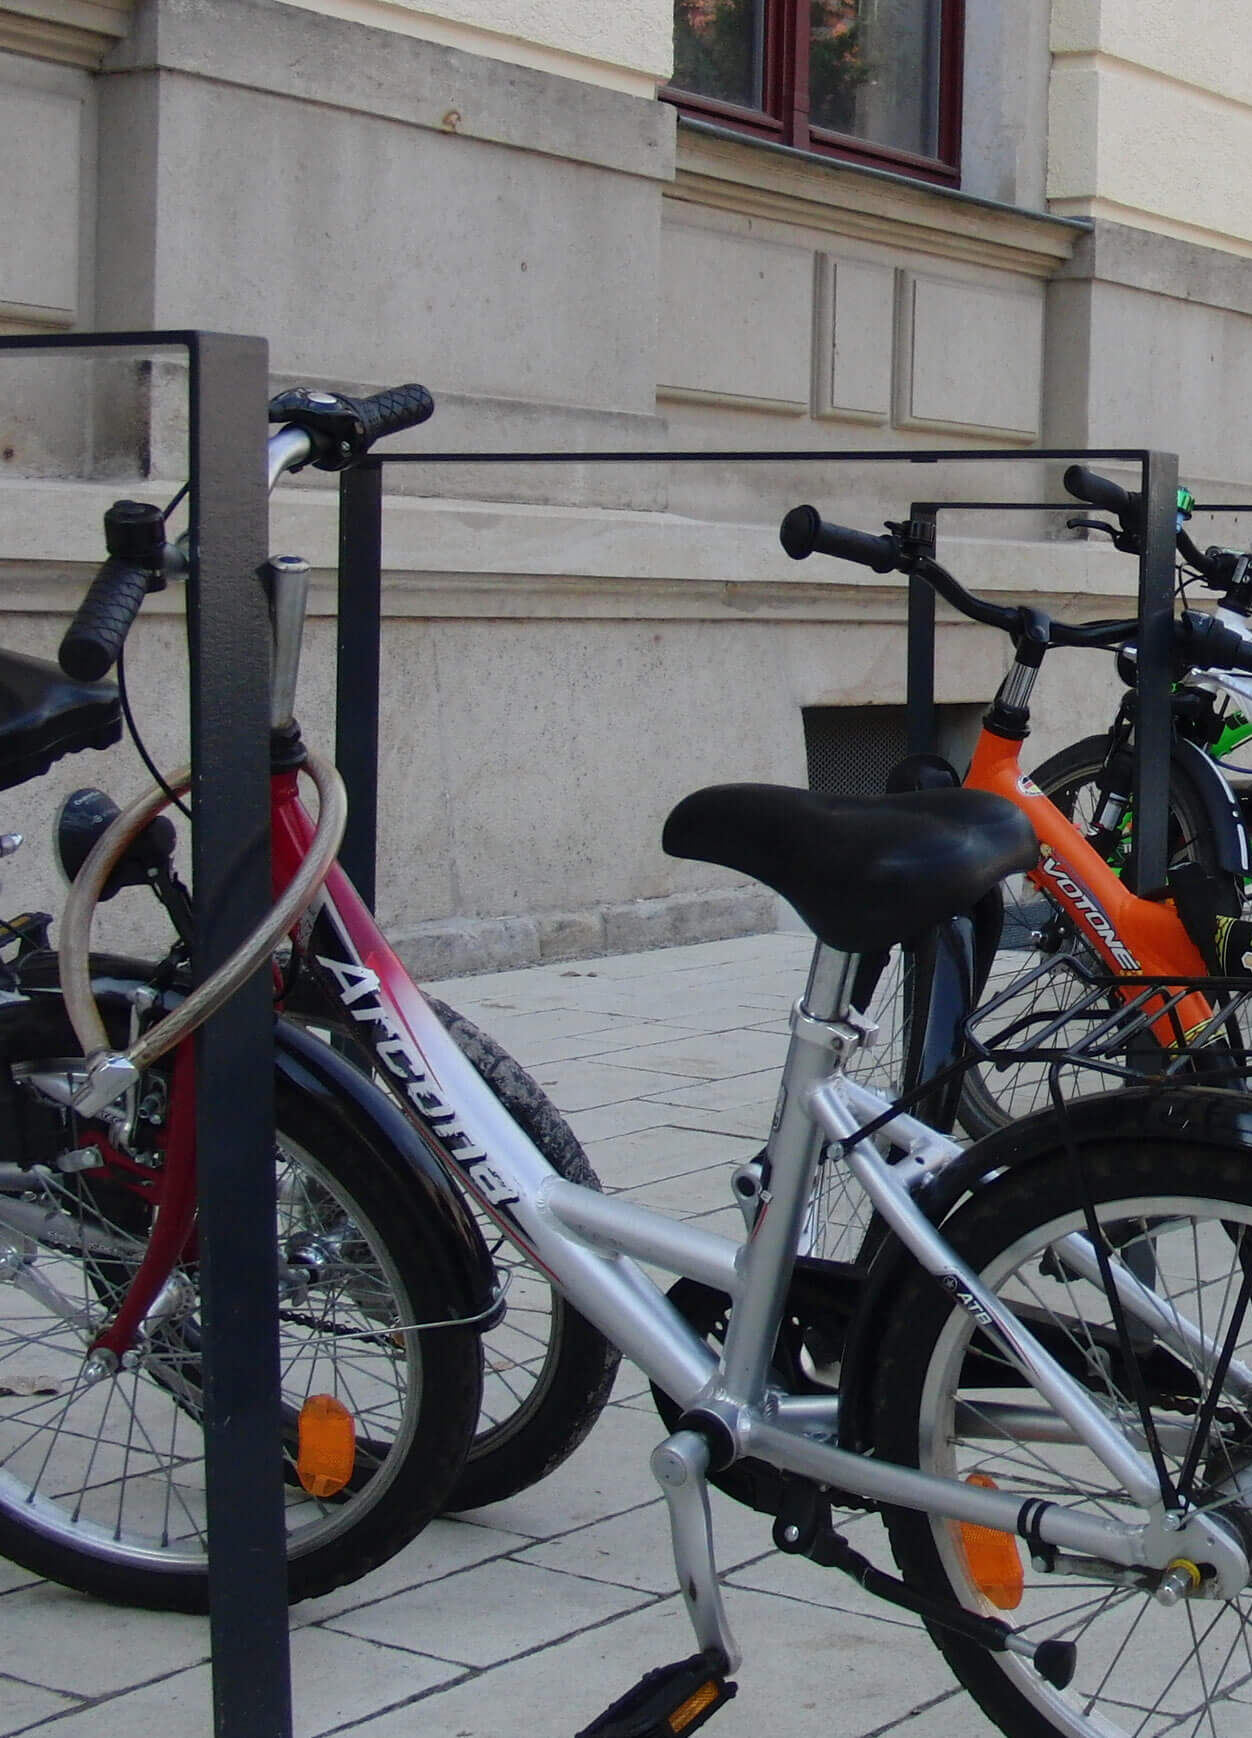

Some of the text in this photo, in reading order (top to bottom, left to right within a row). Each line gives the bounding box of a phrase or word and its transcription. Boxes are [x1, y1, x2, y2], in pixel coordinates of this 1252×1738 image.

[1042, 856, 1141, 972] VOTONE
[315, 954, 520, 1206] Arcona
[957, 1293, 993, 1326] ATB
